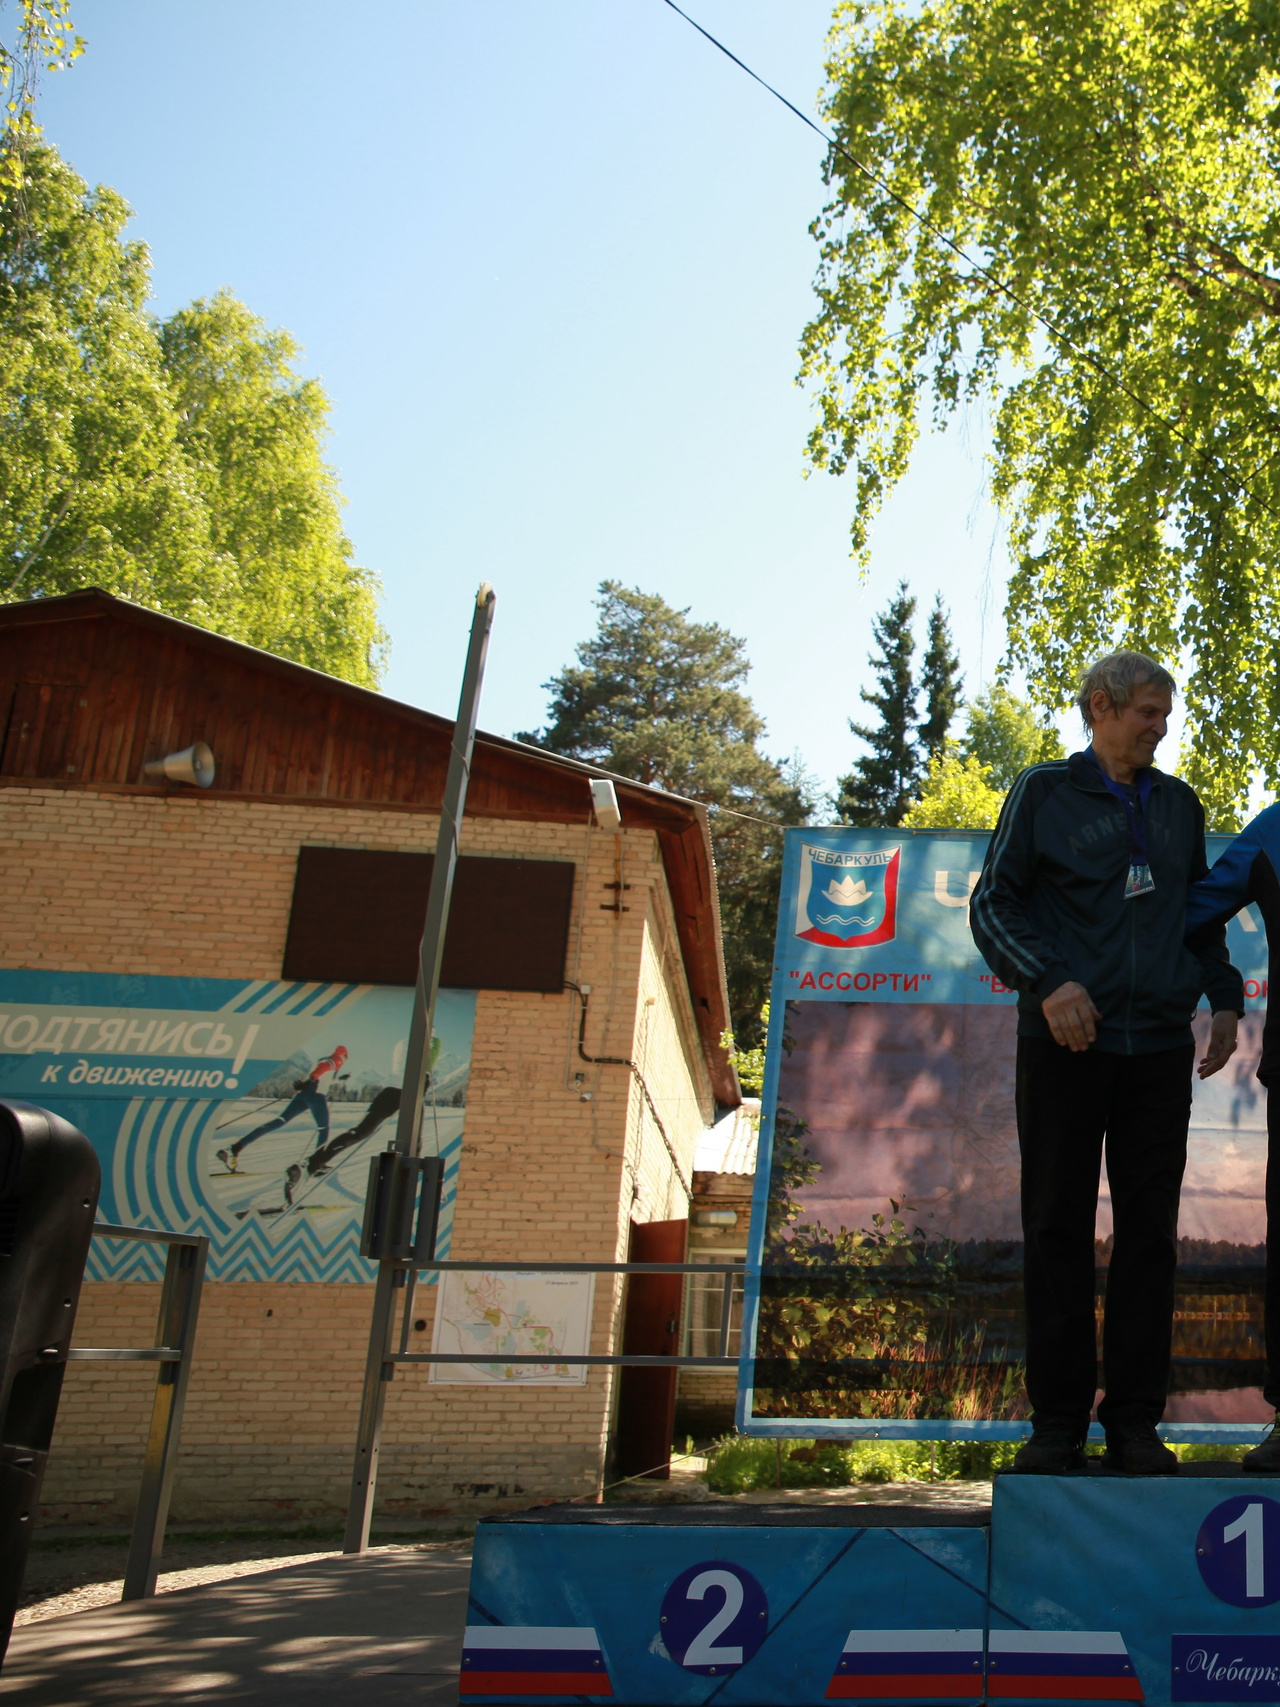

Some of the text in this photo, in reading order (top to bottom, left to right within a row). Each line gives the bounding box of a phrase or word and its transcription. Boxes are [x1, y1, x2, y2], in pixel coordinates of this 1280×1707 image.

[808, 848, 893, 866] ЧЕБАРКУЛЬ
[789, 970, 931, 992] "АССОРТИ"
[40, 1064, 64, 1083] к
[1223, 1503, 1265, 1598] 1
[682, 1569, 744, 1666] 2
